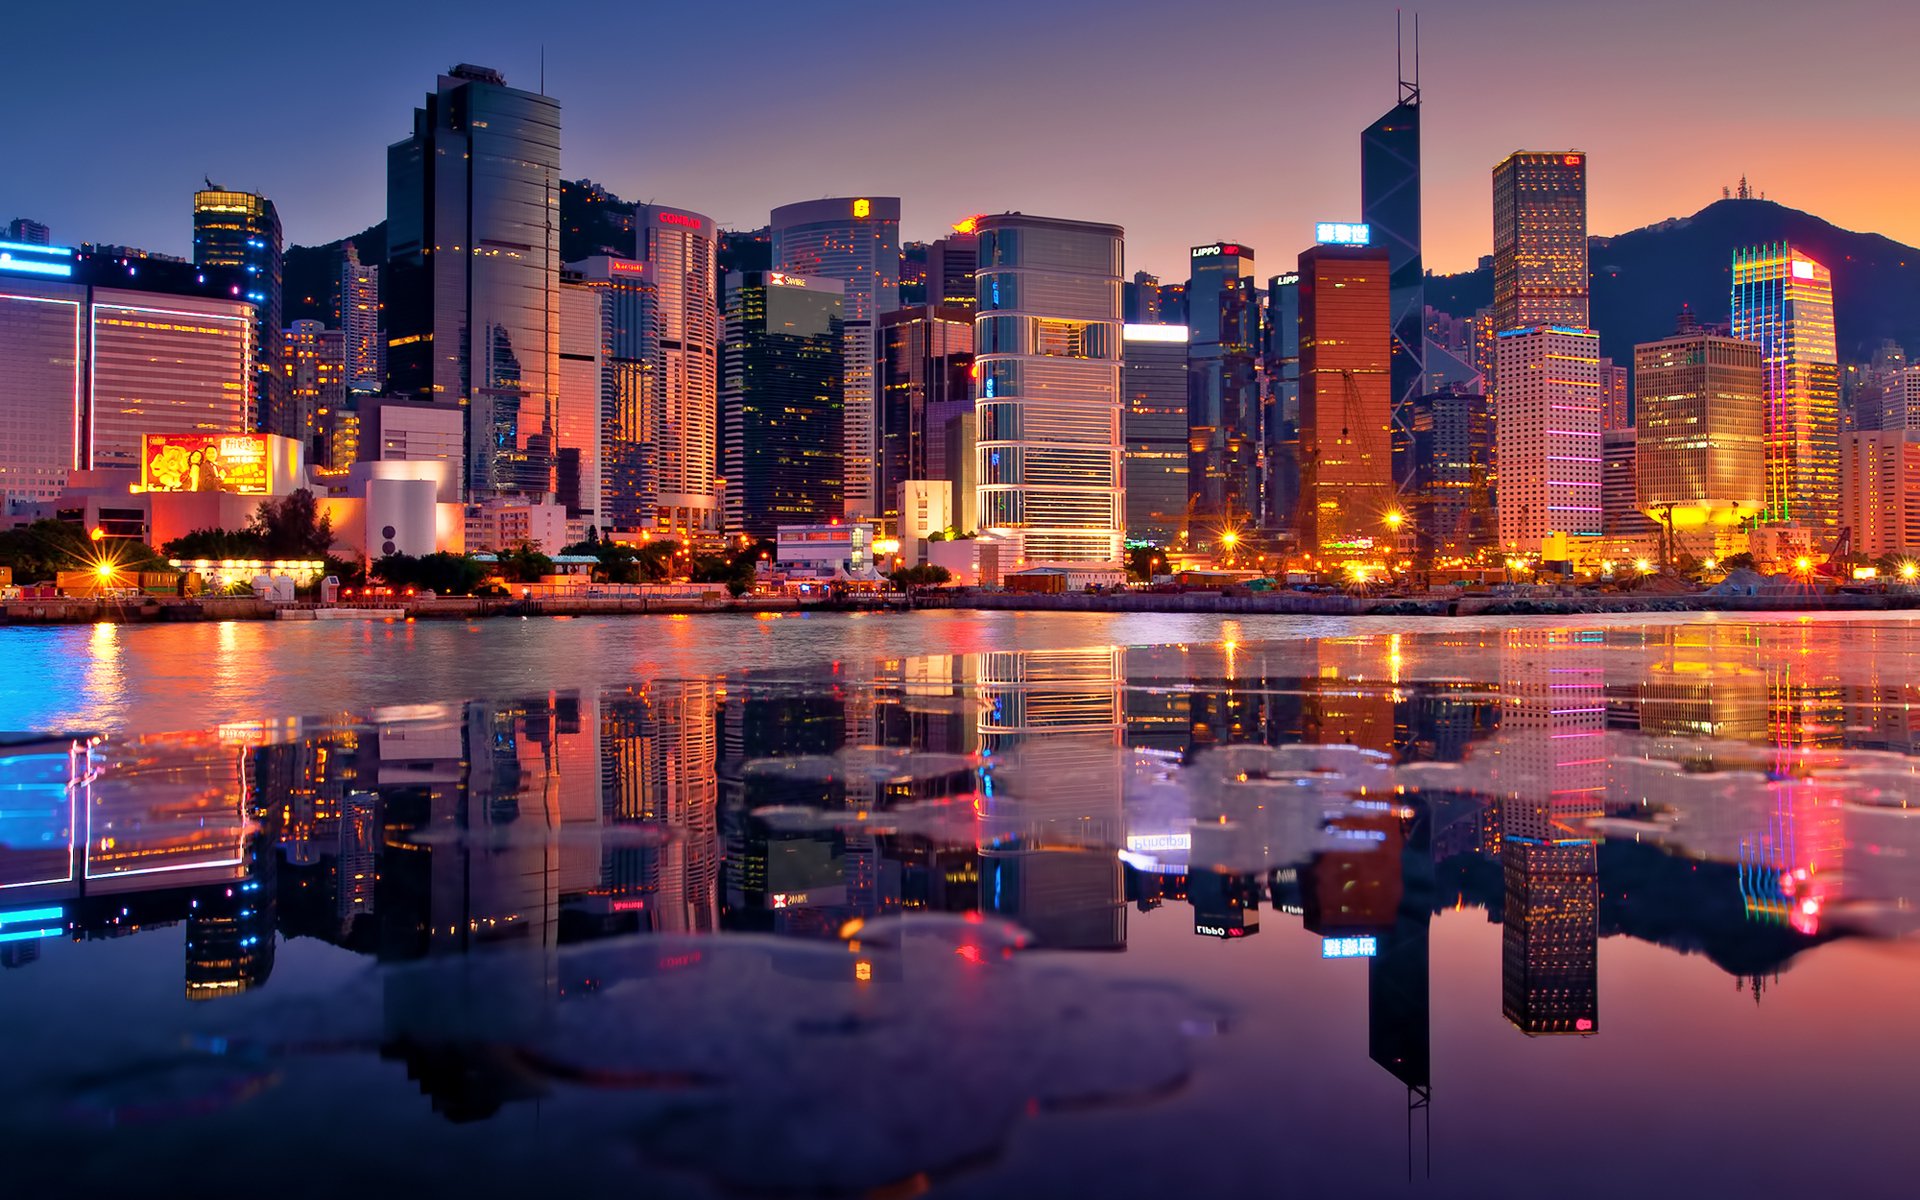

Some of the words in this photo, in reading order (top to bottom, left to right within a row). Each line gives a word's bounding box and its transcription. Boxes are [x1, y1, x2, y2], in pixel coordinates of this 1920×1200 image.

[659, 212, 702, 229] CONRAD
[1192, 246, 1221, 257] LIPPO
[1277, 275, 1299, 285] LIPP
